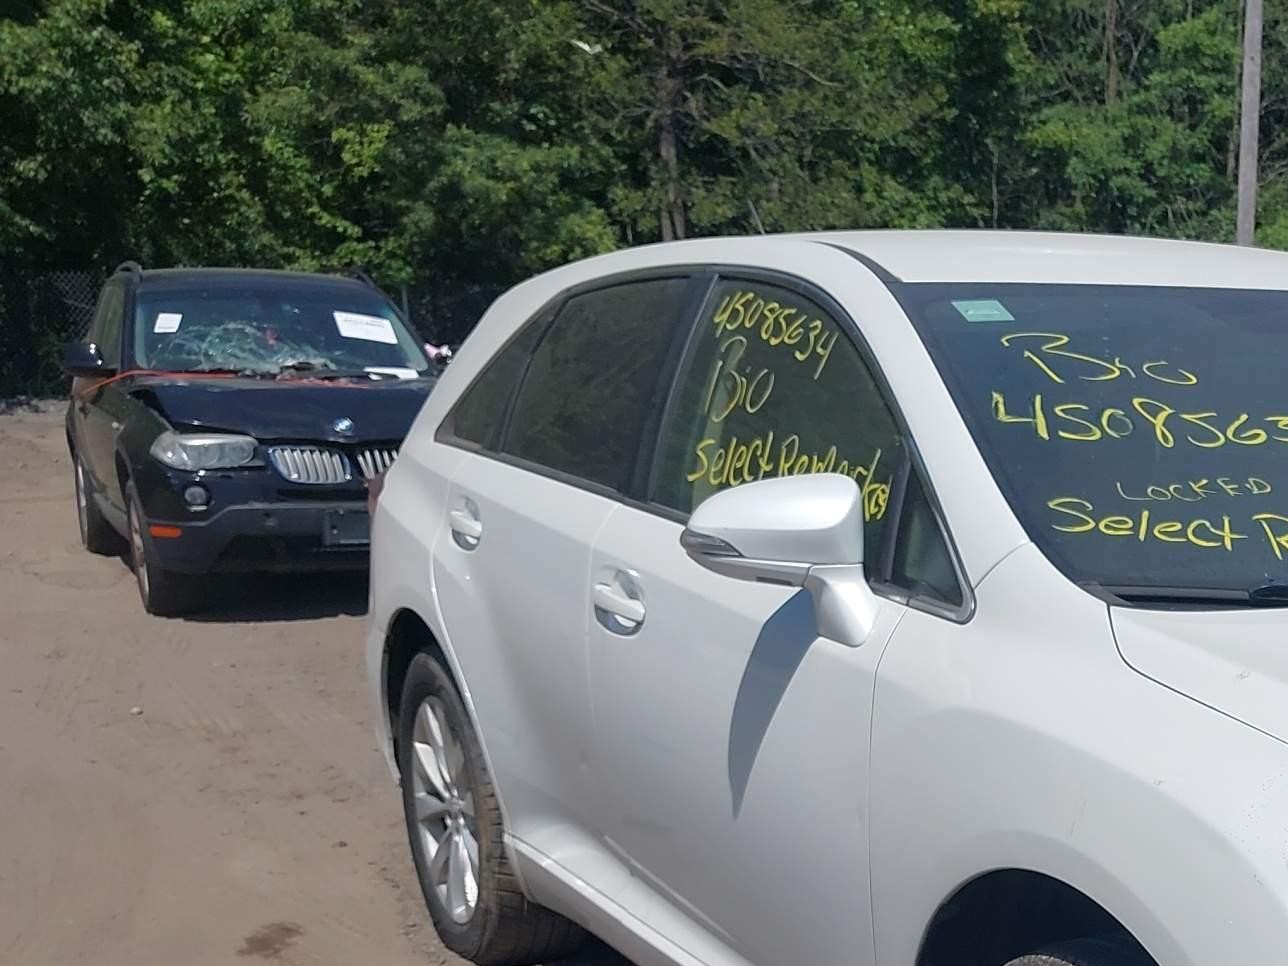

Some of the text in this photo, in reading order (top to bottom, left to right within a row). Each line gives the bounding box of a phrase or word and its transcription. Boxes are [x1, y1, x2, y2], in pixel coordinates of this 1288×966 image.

[714, 292, 839, 380] 45085634
[688, 431, 773, 486] Select
[1117, 477, 1271, 501] LOCKED
[1048, 498, 1248, 551] Select
